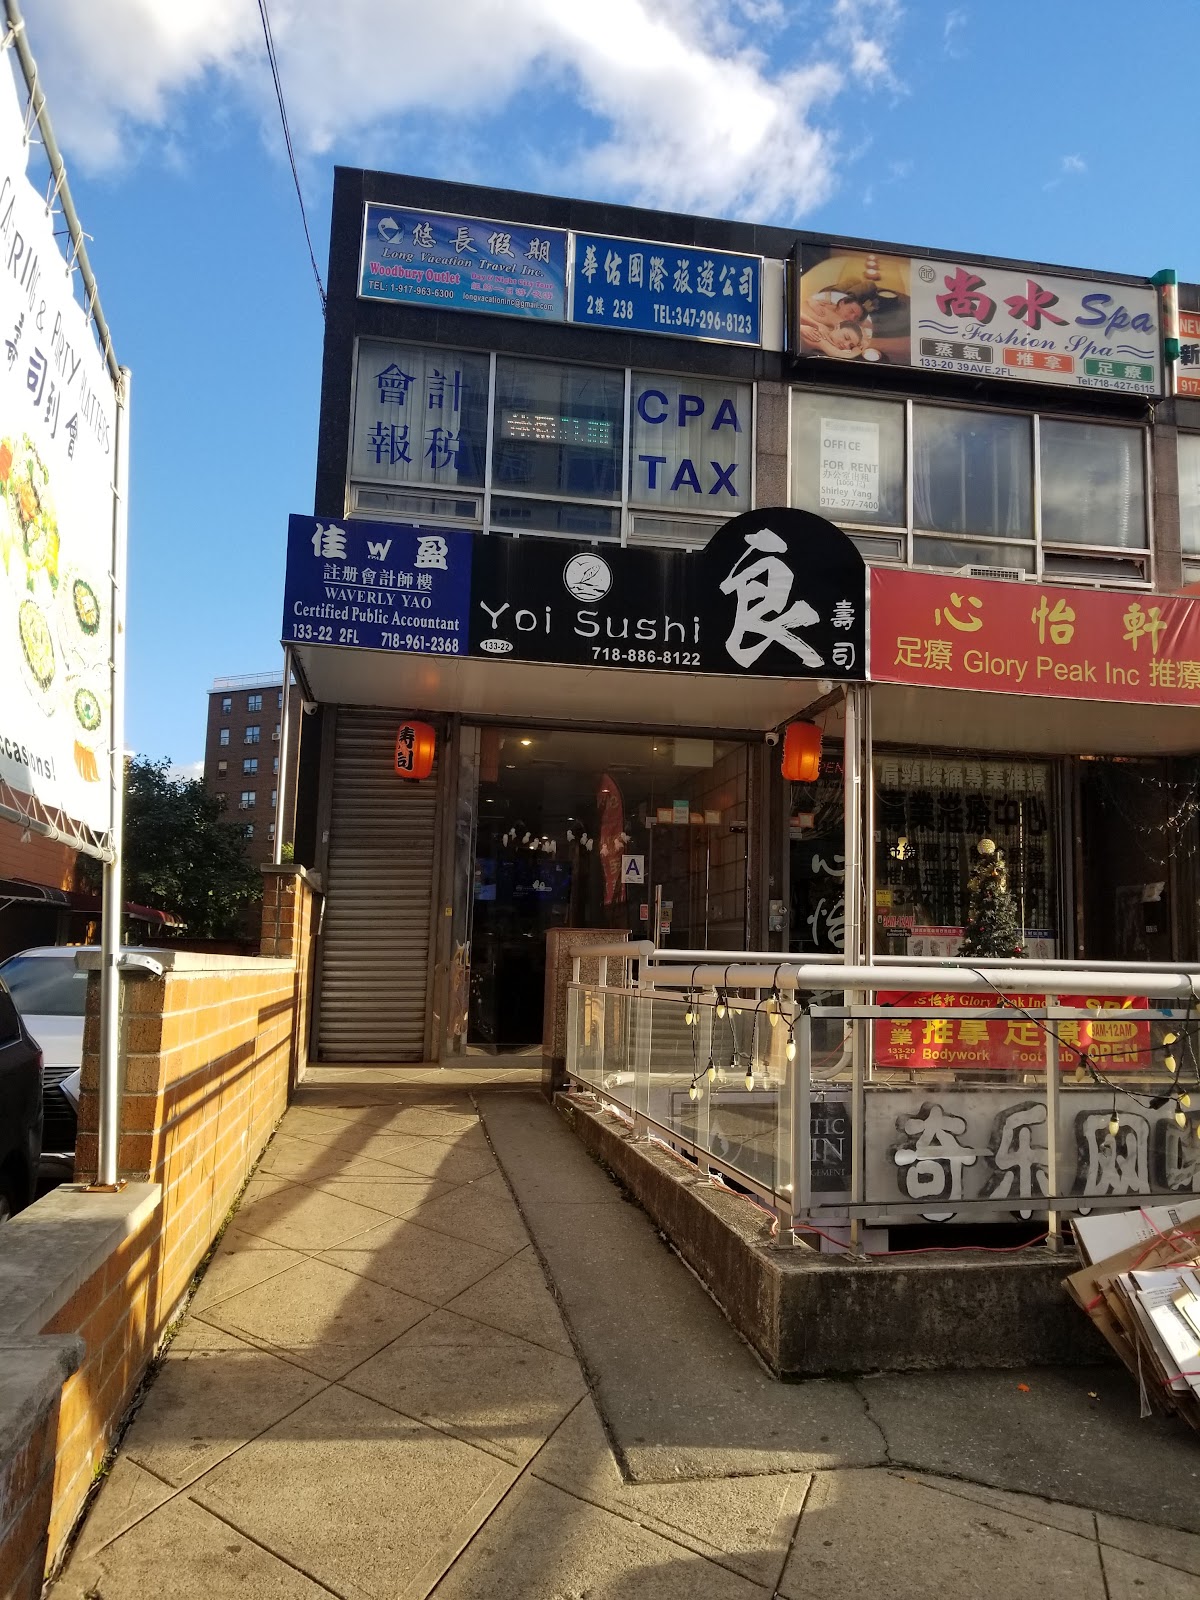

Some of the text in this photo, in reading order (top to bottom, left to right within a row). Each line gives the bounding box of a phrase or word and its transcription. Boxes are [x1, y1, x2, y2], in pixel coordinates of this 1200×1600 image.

[412, 222, 550, 264] 悠長假期
[381, 247, 545, 277] Long Vacation Travel Inc.
[369, 262, 460, 285] Woodbury Outlet
[495, 275, 517, 285] Night
[368, 280, 454, 299] TEL: 1-917-963-6300
[463, 292, 554, 311] longvacationinc@gmail.com
[935, 265, 1157, 338] 尚水 Spa
[613, 299, 634, 320] 238
[653, 303, 752, 335] TEL:347-296-8123
[961, 322, 1114, 359] Fashion Spa
[934, 342, 982, 361] 蒸氣
[1016, 351, 1063, 370] 推拿
[919, 358, 954, 370] 133-20
[1097, 361, 1142, 379] 足療
[372, 362, 471, 412] 會計
[1076, 376, 1155, 393] Tel:718-427-6115
[637, 389, 742, 433] CPA
[823, 439, 861, 451] OFFICE
[638, 455, 741, 496] TAX
[823, 459, 878, 474] FOR RENT
[821, 486, 872, 500] Shirley Yang
[841, 498, 878, 510] 577-7400
[311, 522, 347, 560] 佳
[414, 535, 449, 571] 盈
[325, 587, 432, 609] WAVERLY YAO
[719, 528, 825, 669] 良
[294, 600, 460, 631] Certified Public Accountant
[480, 601, 701, 644] Yoi Sushi
[934, 592, 1167, 655] 心怡軒
[292, 623, 459, 653] 133-22 2FL 718-961-2368
[830, 598, 856, 671] 壽司
[484, 640, 512, 652] 133-22
[592, 646, 701, 666] 718-886-8122
[893, 636, 1200, 690] 足療 Glory Peak Inc 推療
[397, 725, 415, 771] 寿司
[626, 858, 640, 876] A
[959, 995, 993, 1008] Glory
[1091, 1023, 1132, 1037] 9AM-12AM
[922, 1048, 1074, 1062] Bodywork Foot ub
[1088, 1043, 1138, 1063] OPEN
[810, 1118, 845, 1135] TIC
[811, 1138, 846, 1162] IN
[811, 1168, 845, 1176] GEMENT
